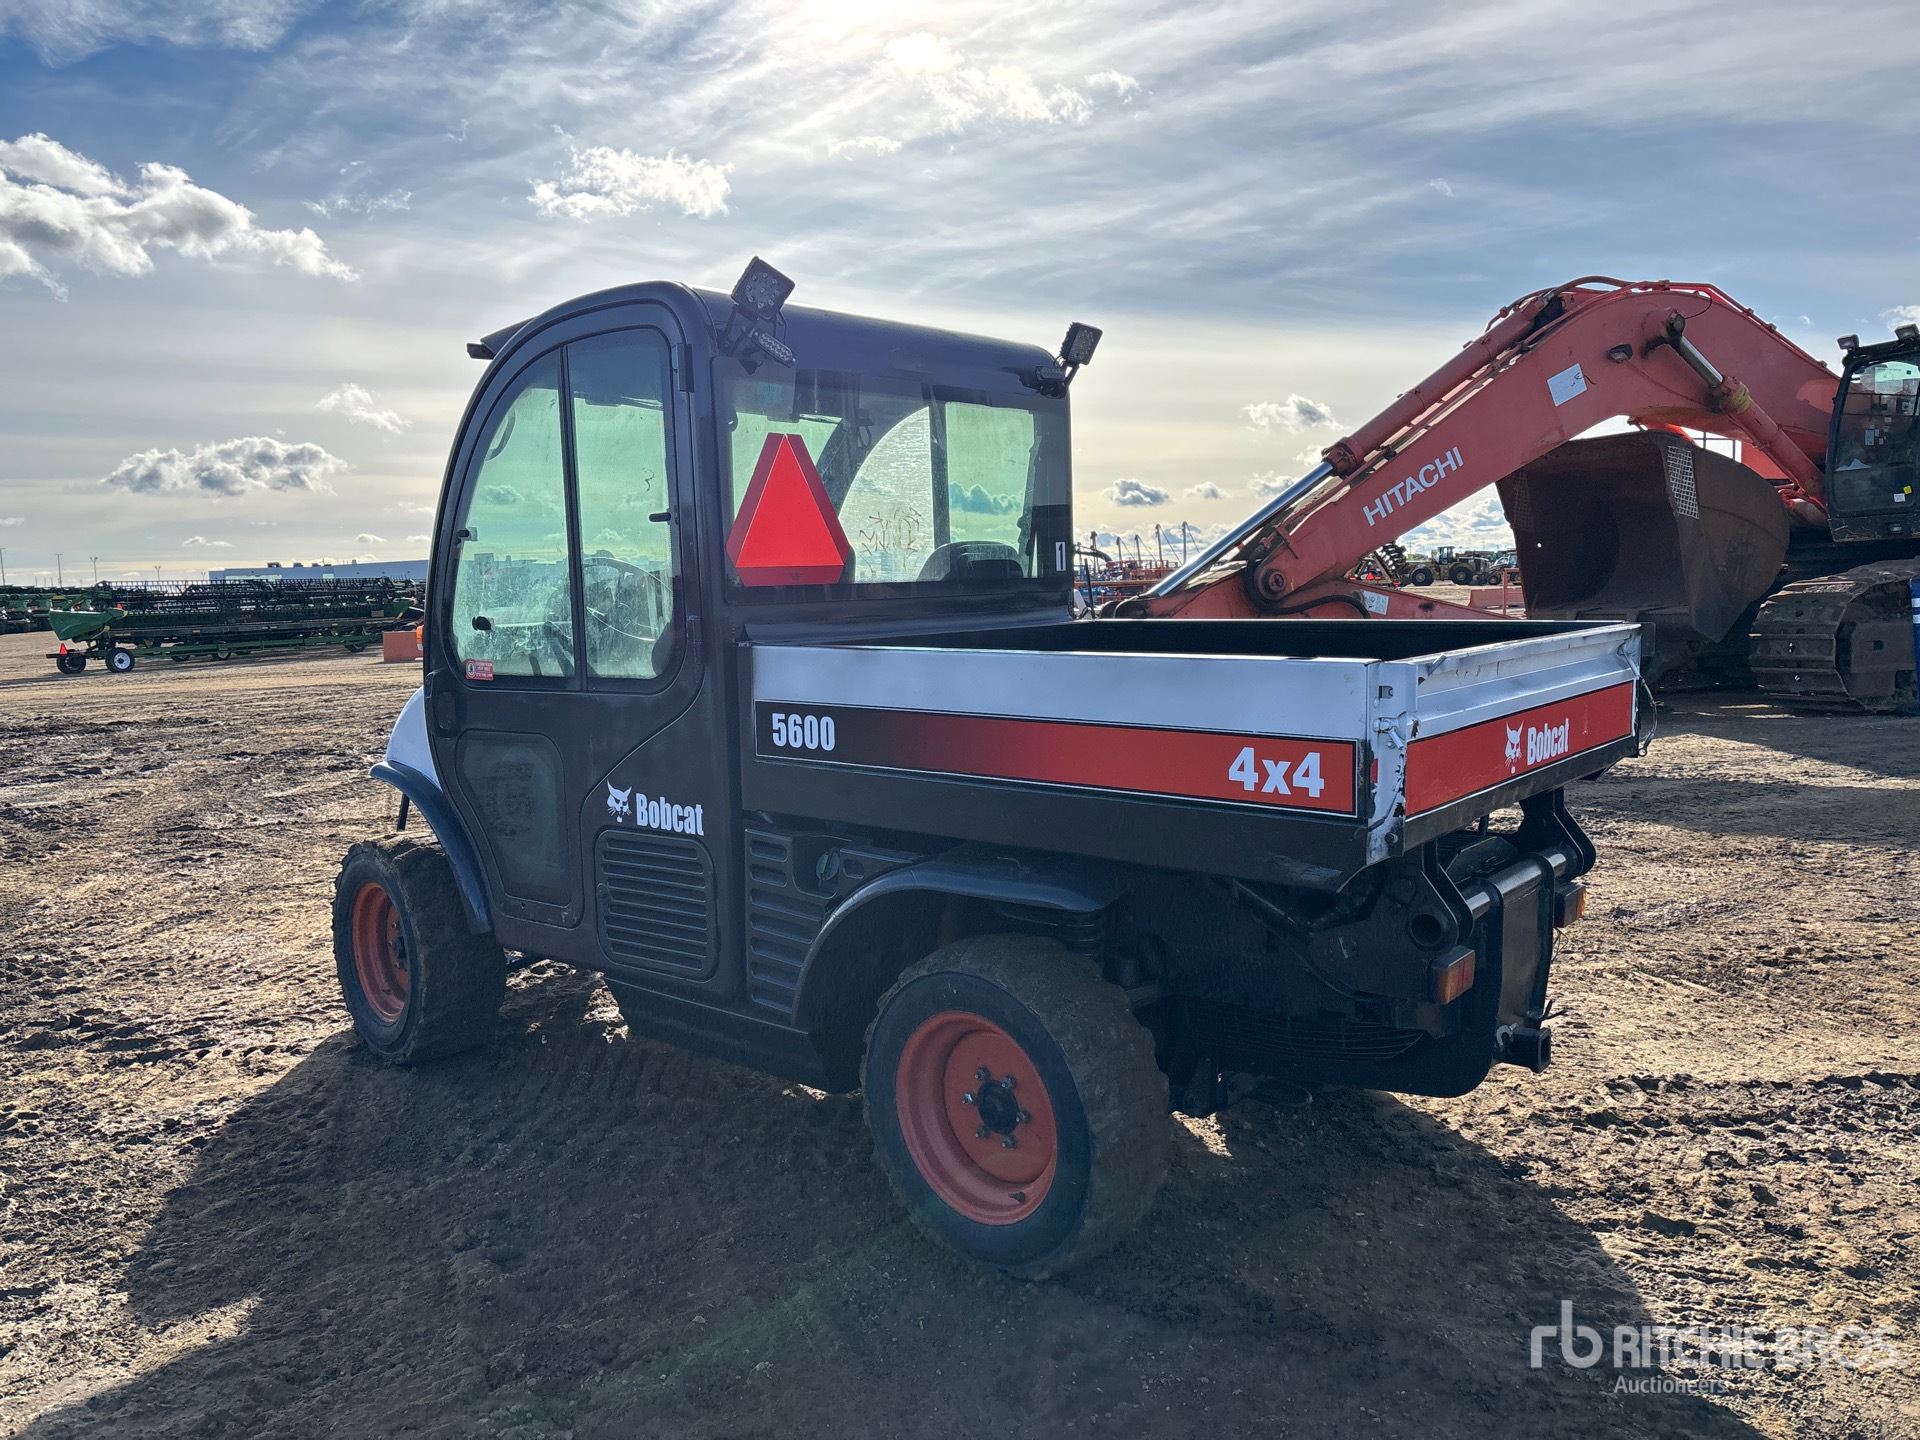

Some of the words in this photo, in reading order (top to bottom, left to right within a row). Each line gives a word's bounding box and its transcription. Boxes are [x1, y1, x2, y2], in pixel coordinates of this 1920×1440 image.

[1363, 446, 1464, 527] HITACHI
[772, 712, 836, 752] 5600
[1526, 717, 1570, 766] Bobcat
[1228, 746, 1325, 798] 4x4
[635, 792, 704, 837] Bobcat
